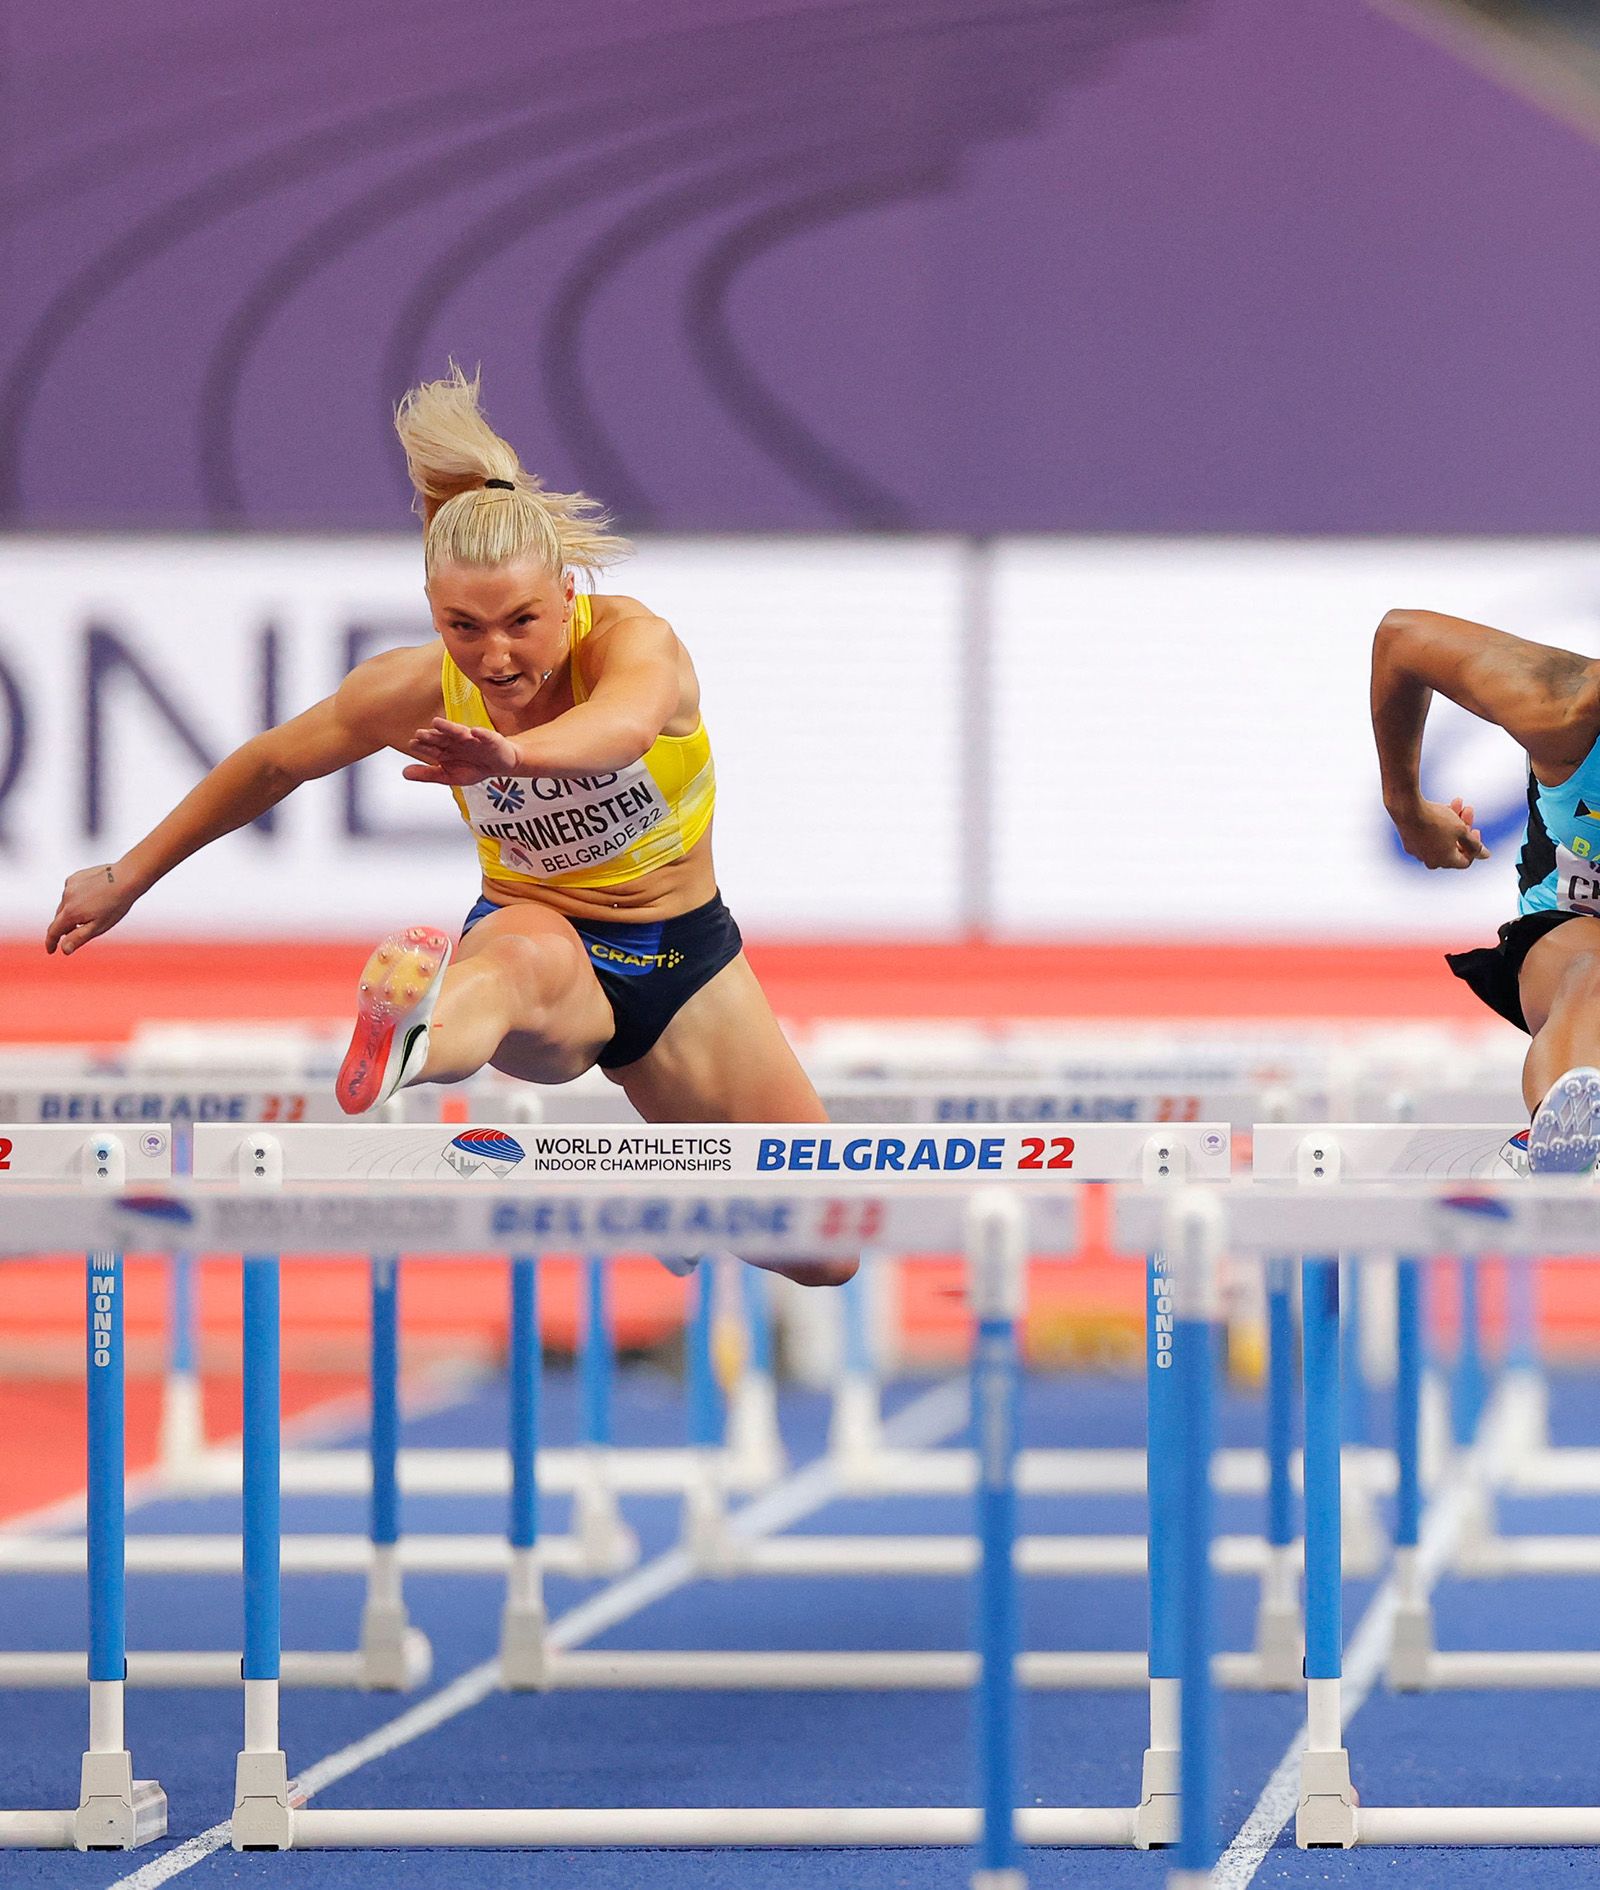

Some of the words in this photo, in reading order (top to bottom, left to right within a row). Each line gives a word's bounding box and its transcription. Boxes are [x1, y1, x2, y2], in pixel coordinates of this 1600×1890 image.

[480, 780, 654, 852] WENNERSTEN
[541, 823, 637, 873] BELGRADE
[639, 807, 663, 830] 22
[590, 943, 667, 969] CRAFT
[534, 1158, 597, 1171] INDOOR
[600, 1158, 732, 1171] CHAMPIONSHIPS
[535, 1138, 611, 1155] WORLD
[617, 1138, 732, 1155] ATHLETICS
[756, 1138, 1005, 1171] BELGRADE
[1017, 1137, 1076, 1170] 22
[92, 1276, 115, 1367] MONDO
[1153, 1278, 1174, 1369] MONDO
